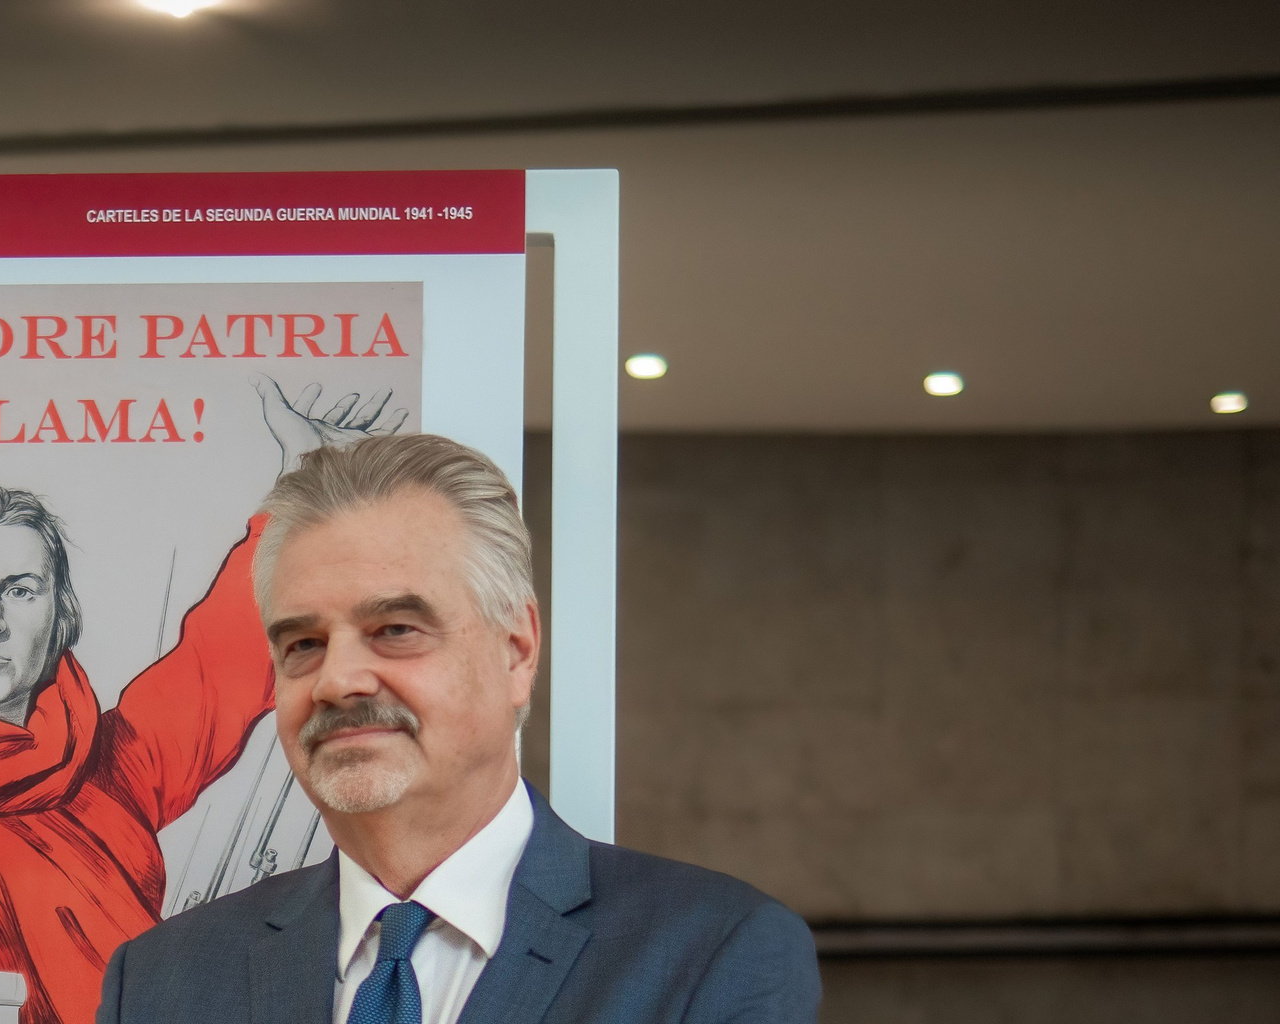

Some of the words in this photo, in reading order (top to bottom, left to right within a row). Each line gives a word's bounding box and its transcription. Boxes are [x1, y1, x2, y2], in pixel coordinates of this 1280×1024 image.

[86, 209, 159, 223] CARTELES
[162, 209, 181, 222] DE
[185, 209, 203, 222] LA
[206, 208, 274, 222] SEGUNDA
[276, 207, 335, 221] GUERRA
[338, 207, 401, 221] MUNDIAL
[404, 207, 433, 220] 1941
[437, 207, 473, 220] -1945
[139, 312, 410, 360] PATRIA
